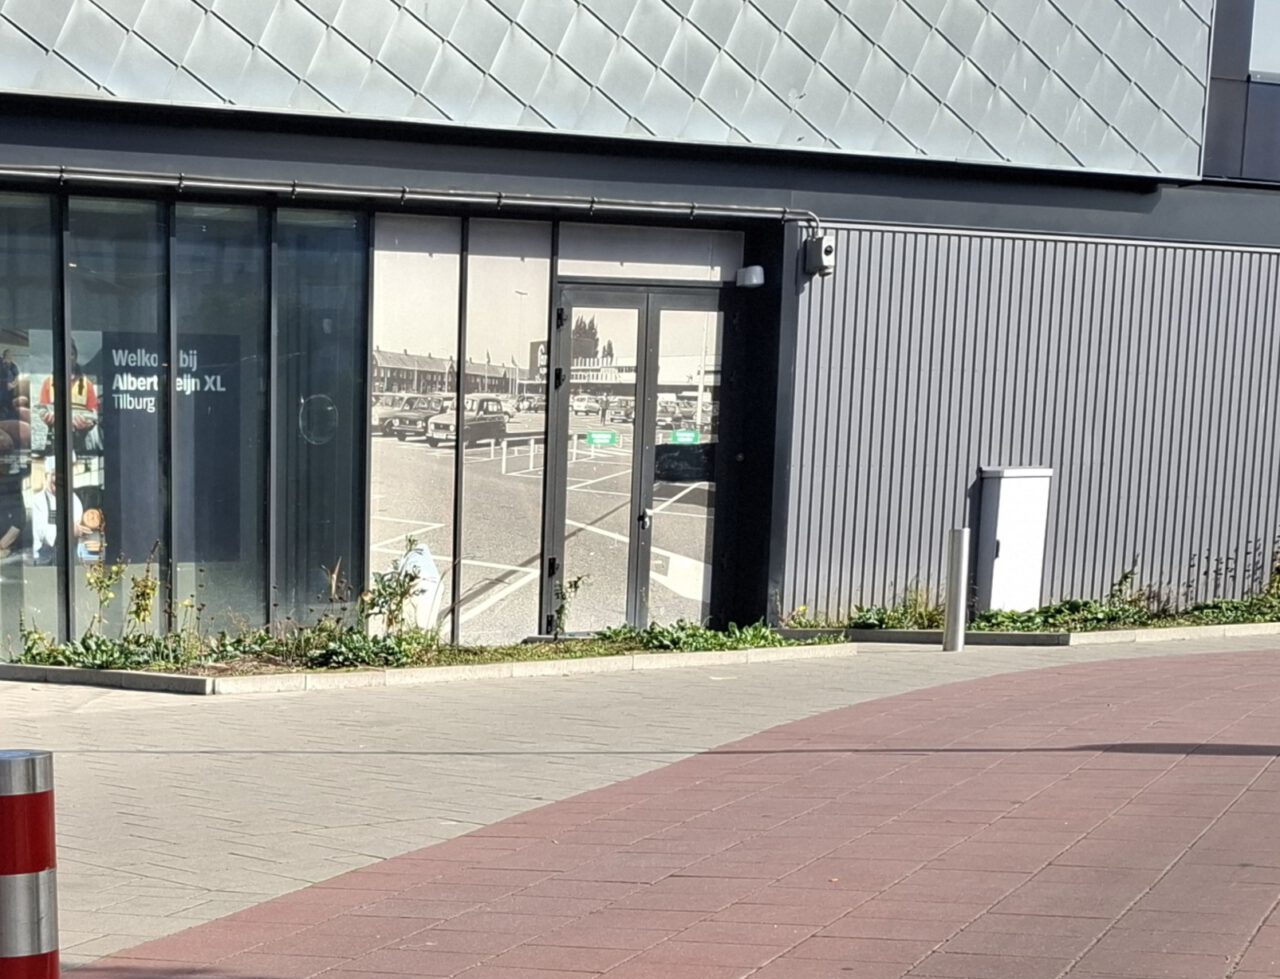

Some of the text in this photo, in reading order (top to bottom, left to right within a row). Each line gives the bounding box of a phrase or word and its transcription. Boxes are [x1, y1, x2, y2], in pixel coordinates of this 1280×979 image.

[112, 349, 198, 371] Welko bij
[112, 372, 226, 395] Albert eijn XL
[112, 394, 156, 413] Tilburg
